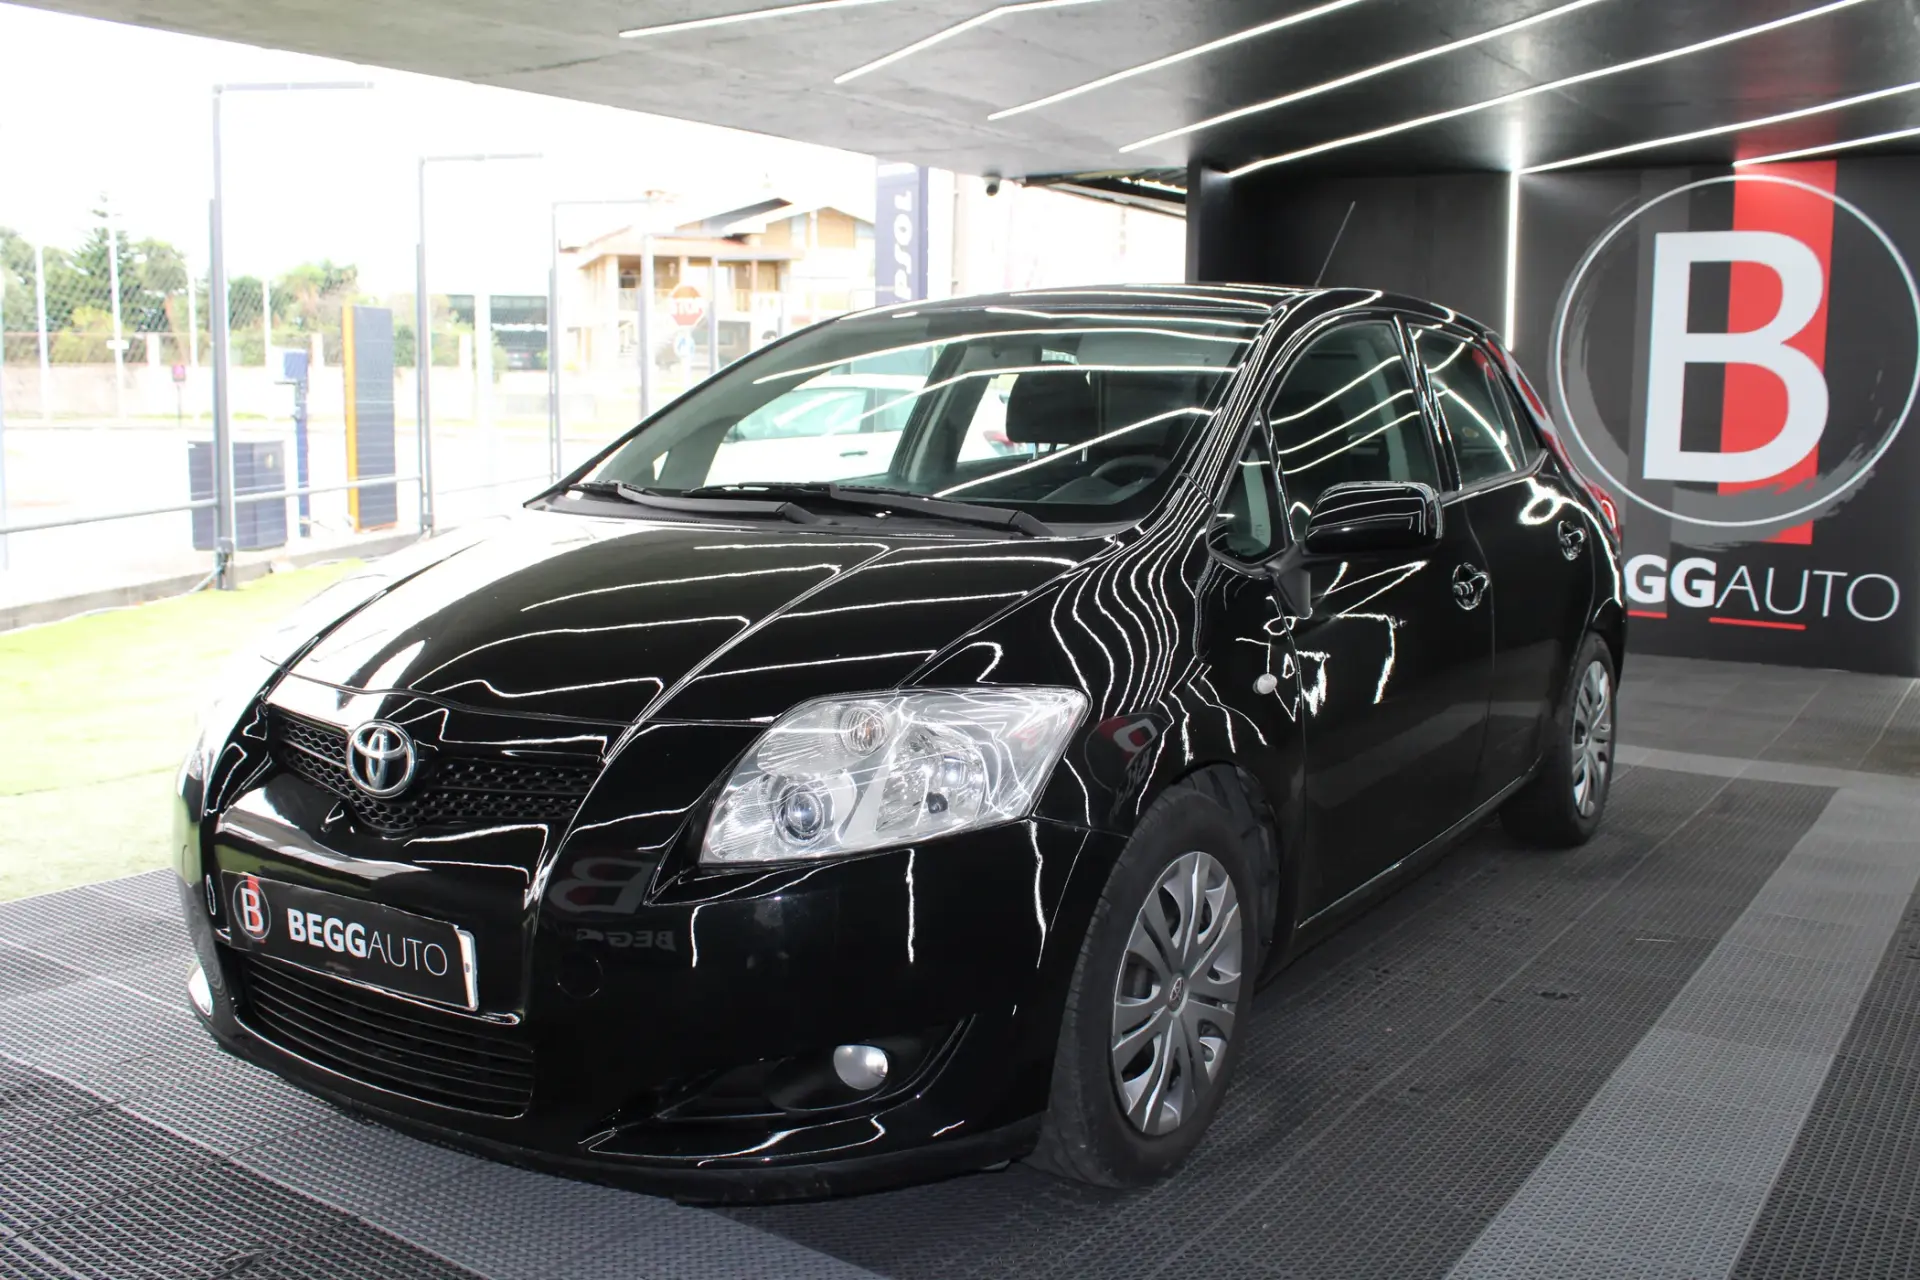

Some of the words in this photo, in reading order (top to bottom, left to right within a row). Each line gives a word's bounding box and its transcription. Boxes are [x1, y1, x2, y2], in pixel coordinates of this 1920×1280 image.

[893, 190, 912, 302] PSOL
[1643, 230, 1829, 483] B
[241, 887, 264, 933] B
[287, 908, 448, 977] BEGGAUTO
